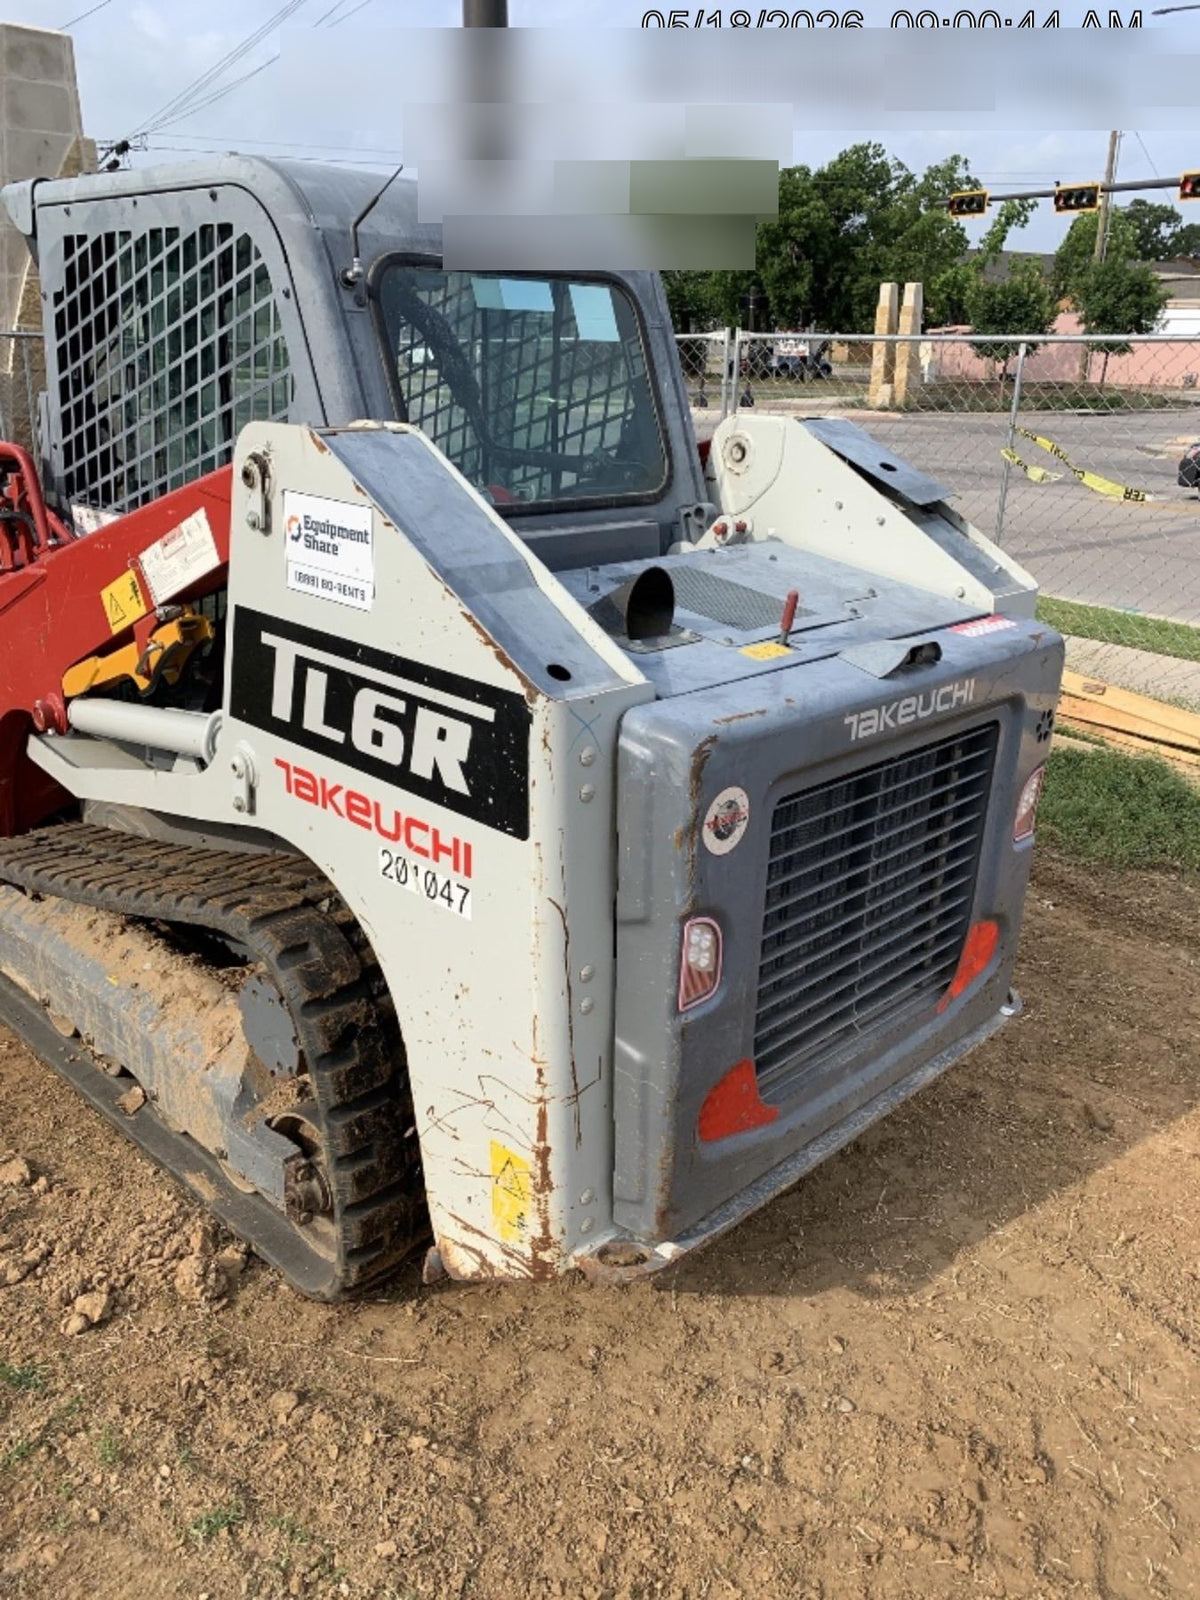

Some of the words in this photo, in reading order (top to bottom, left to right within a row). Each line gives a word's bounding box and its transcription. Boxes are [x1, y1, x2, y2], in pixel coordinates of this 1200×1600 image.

[303, 515, 370, 544] Equipment
[304, 534, 339, 556] Share
[261, 631, 496, 797] TL6R
